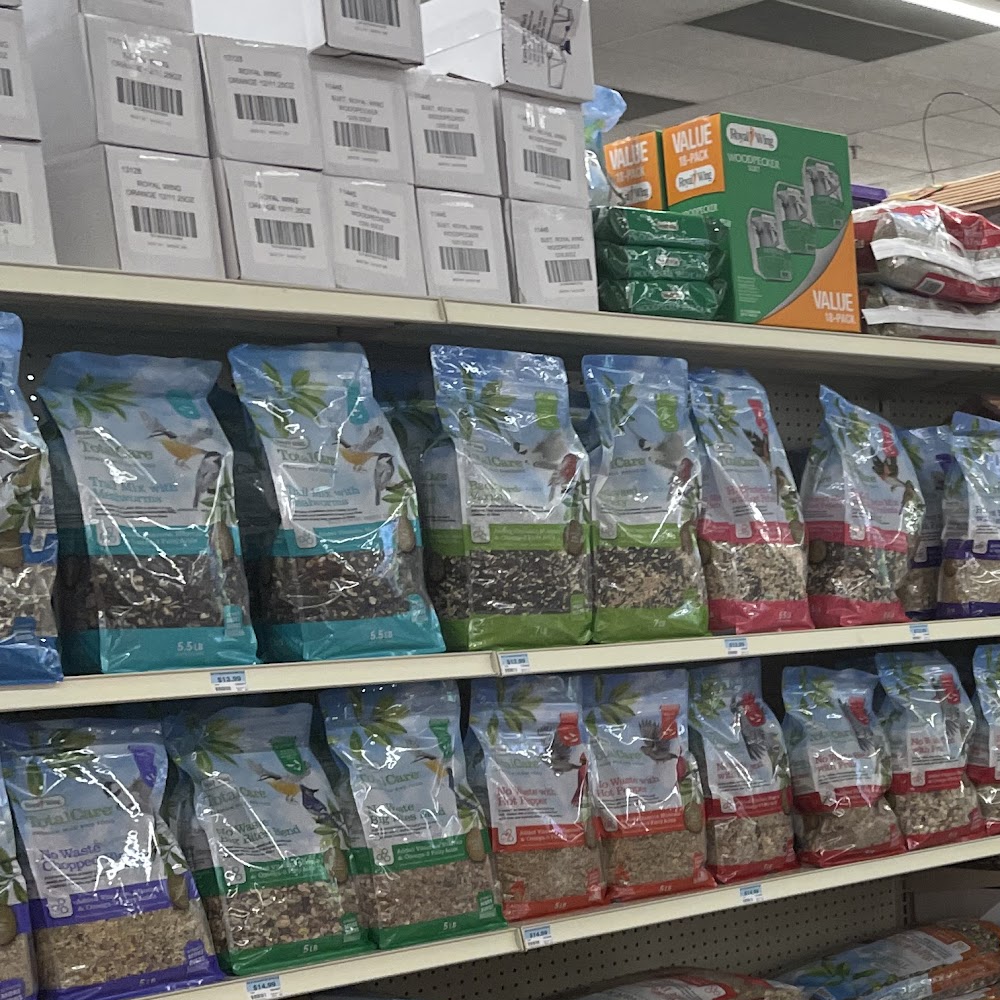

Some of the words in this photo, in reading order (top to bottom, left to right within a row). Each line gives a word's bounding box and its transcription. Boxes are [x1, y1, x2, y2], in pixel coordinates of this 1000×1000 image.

[671, 122, 713, 154] VALUE
[729, 128, 749, 143] Royal
[754, 132, 775, 148] Wing
[608, 140, 649, 171] VALUE
[678, 150, 709, 167] 18-PACK
[727, 153, 780, 169] WOODPECKER
[812, 289, 855, 313] VALUE
